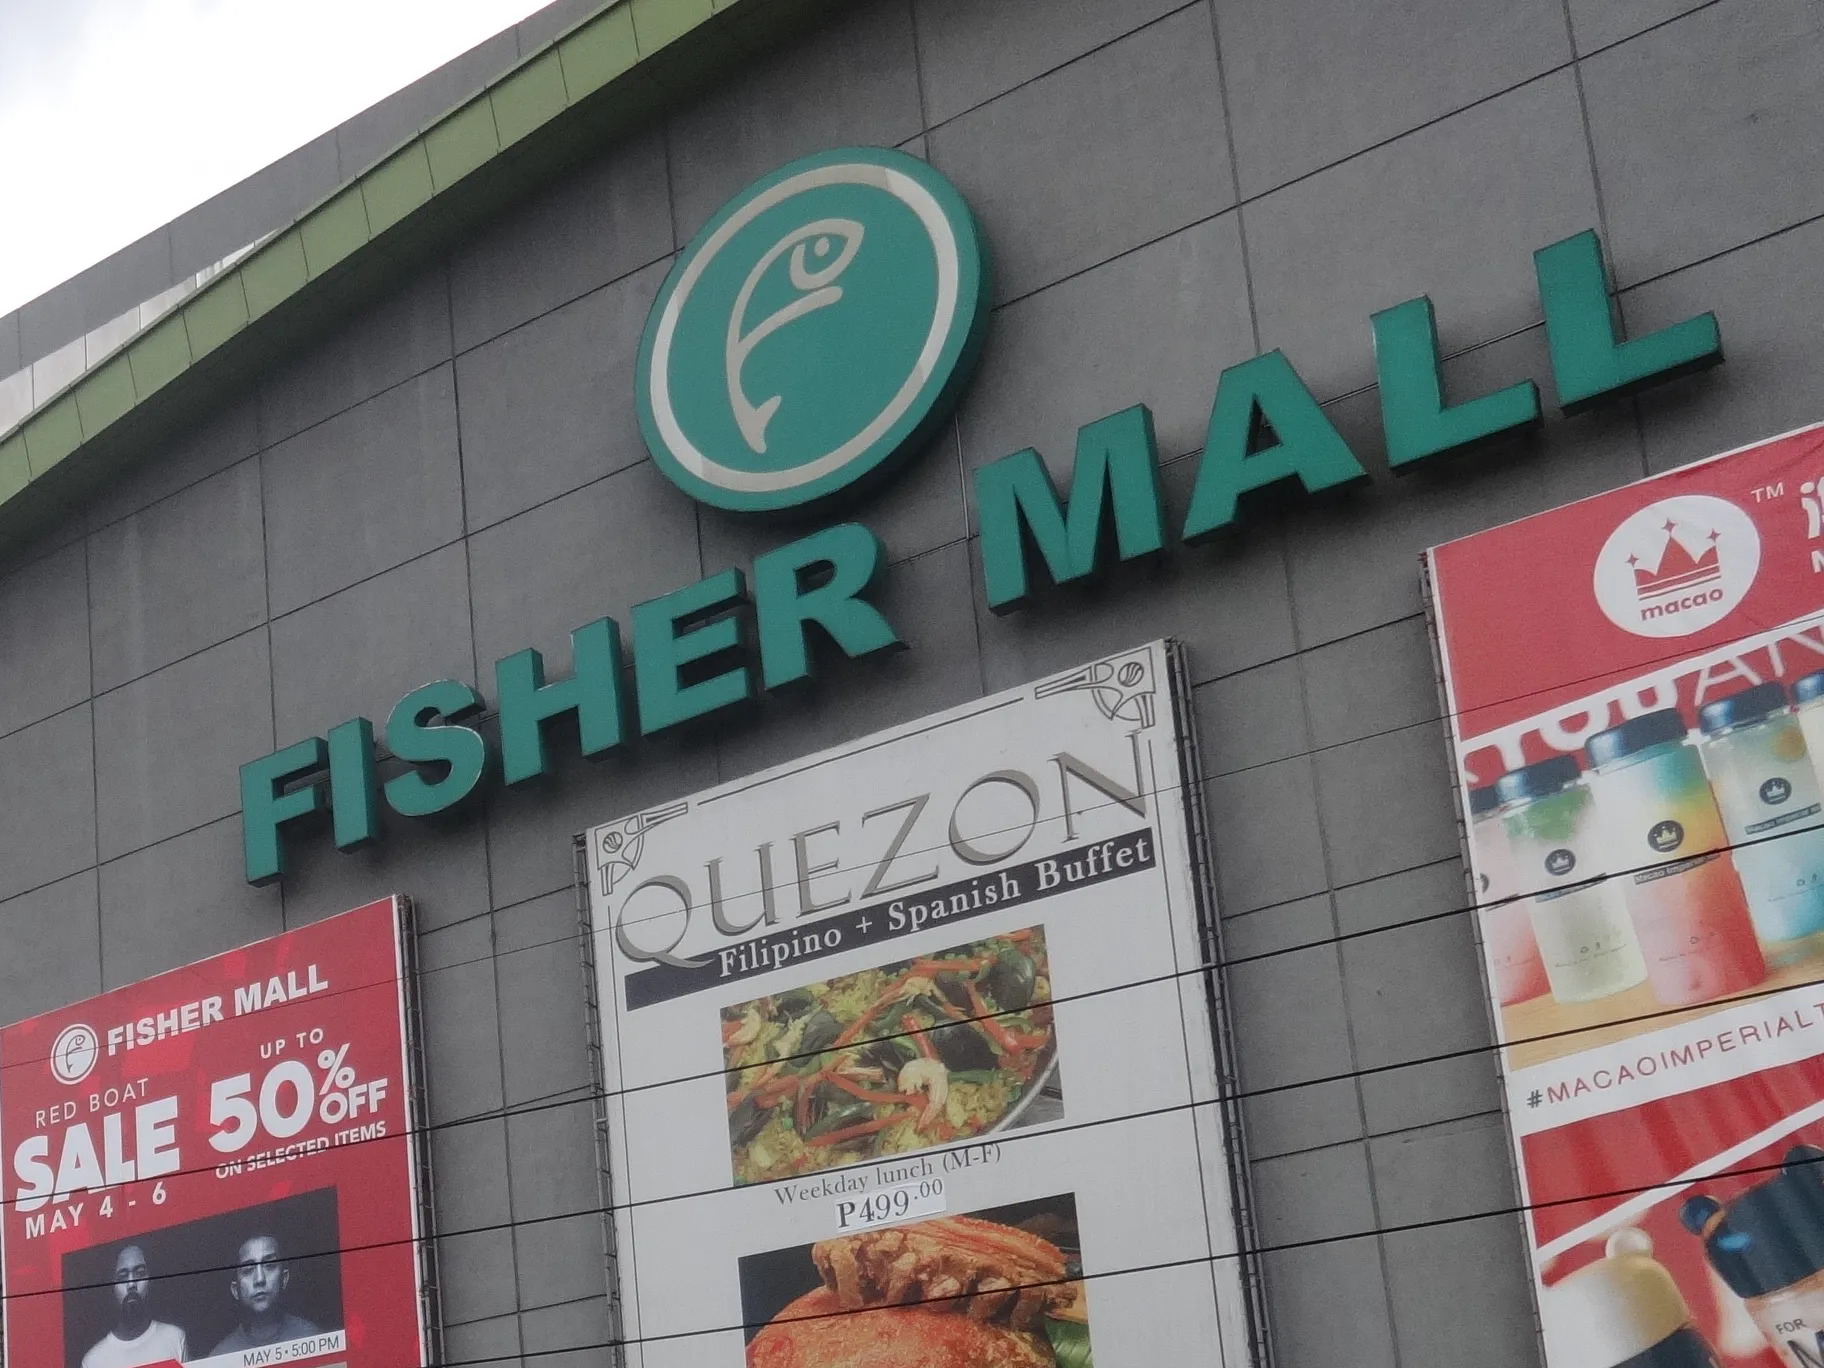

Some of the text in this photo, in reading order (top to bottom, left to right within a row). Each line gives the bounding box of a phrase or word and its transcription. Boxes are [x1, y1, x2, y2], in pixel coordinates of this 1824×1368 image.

[238, 226, 1721, 885] FISHER MALL
[1640, 587, 1723, 620] macao
[616, 729, 1149, 969] QUEZON
[717, 836, 1151, 978] Filipino Spanish Buffet
[107, 964, 329, 1056] FISHER MALL
[260, 1028, 324, 1060] UP TO
[36, 1078, 150, 1128] RED BOAT
[208, 1043, 388, 1153] 50% OFF
[14, 1095, 181, 1213] SALE
[215, 1121, 387, 1179] ON SELECTED ITEMS
[774, 1143, 1001, 1206] Weekday lunch (M-F)
[26, 1182, 166, 1239] MAY 4 6
[243, 1336, 340, 1368] MAY 5 5:00 PM
